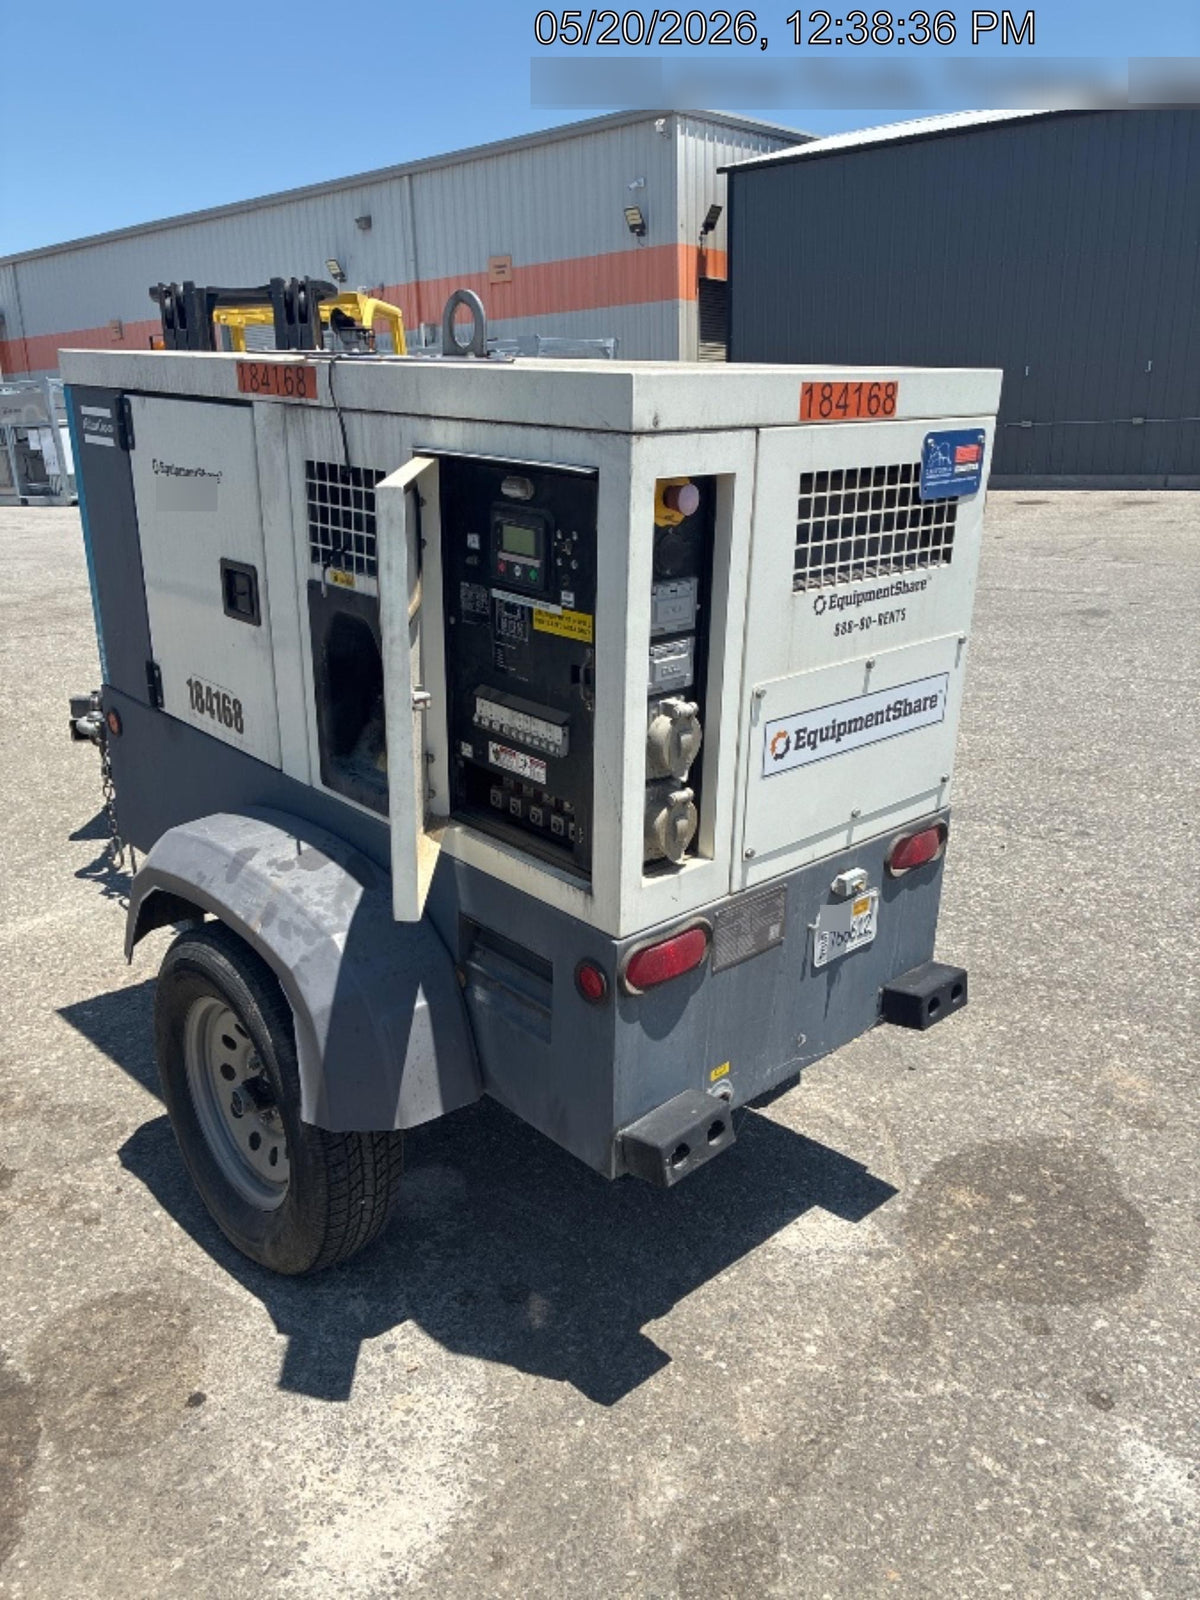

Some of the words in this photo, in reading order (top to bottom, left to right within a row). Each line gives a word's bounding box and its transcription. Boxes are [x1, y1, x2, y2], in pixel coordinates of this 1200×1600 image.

[239, 362, 306, 398] 184168
[804, 382, 896, 418] 184168
[828, 579, 927, 610] EquipmentShare
[834, 608, 906, 636] 888-80-RENTS
[186, 677, 244, 735] 184168
[794, 693, 938, 751] EquipmentShare
